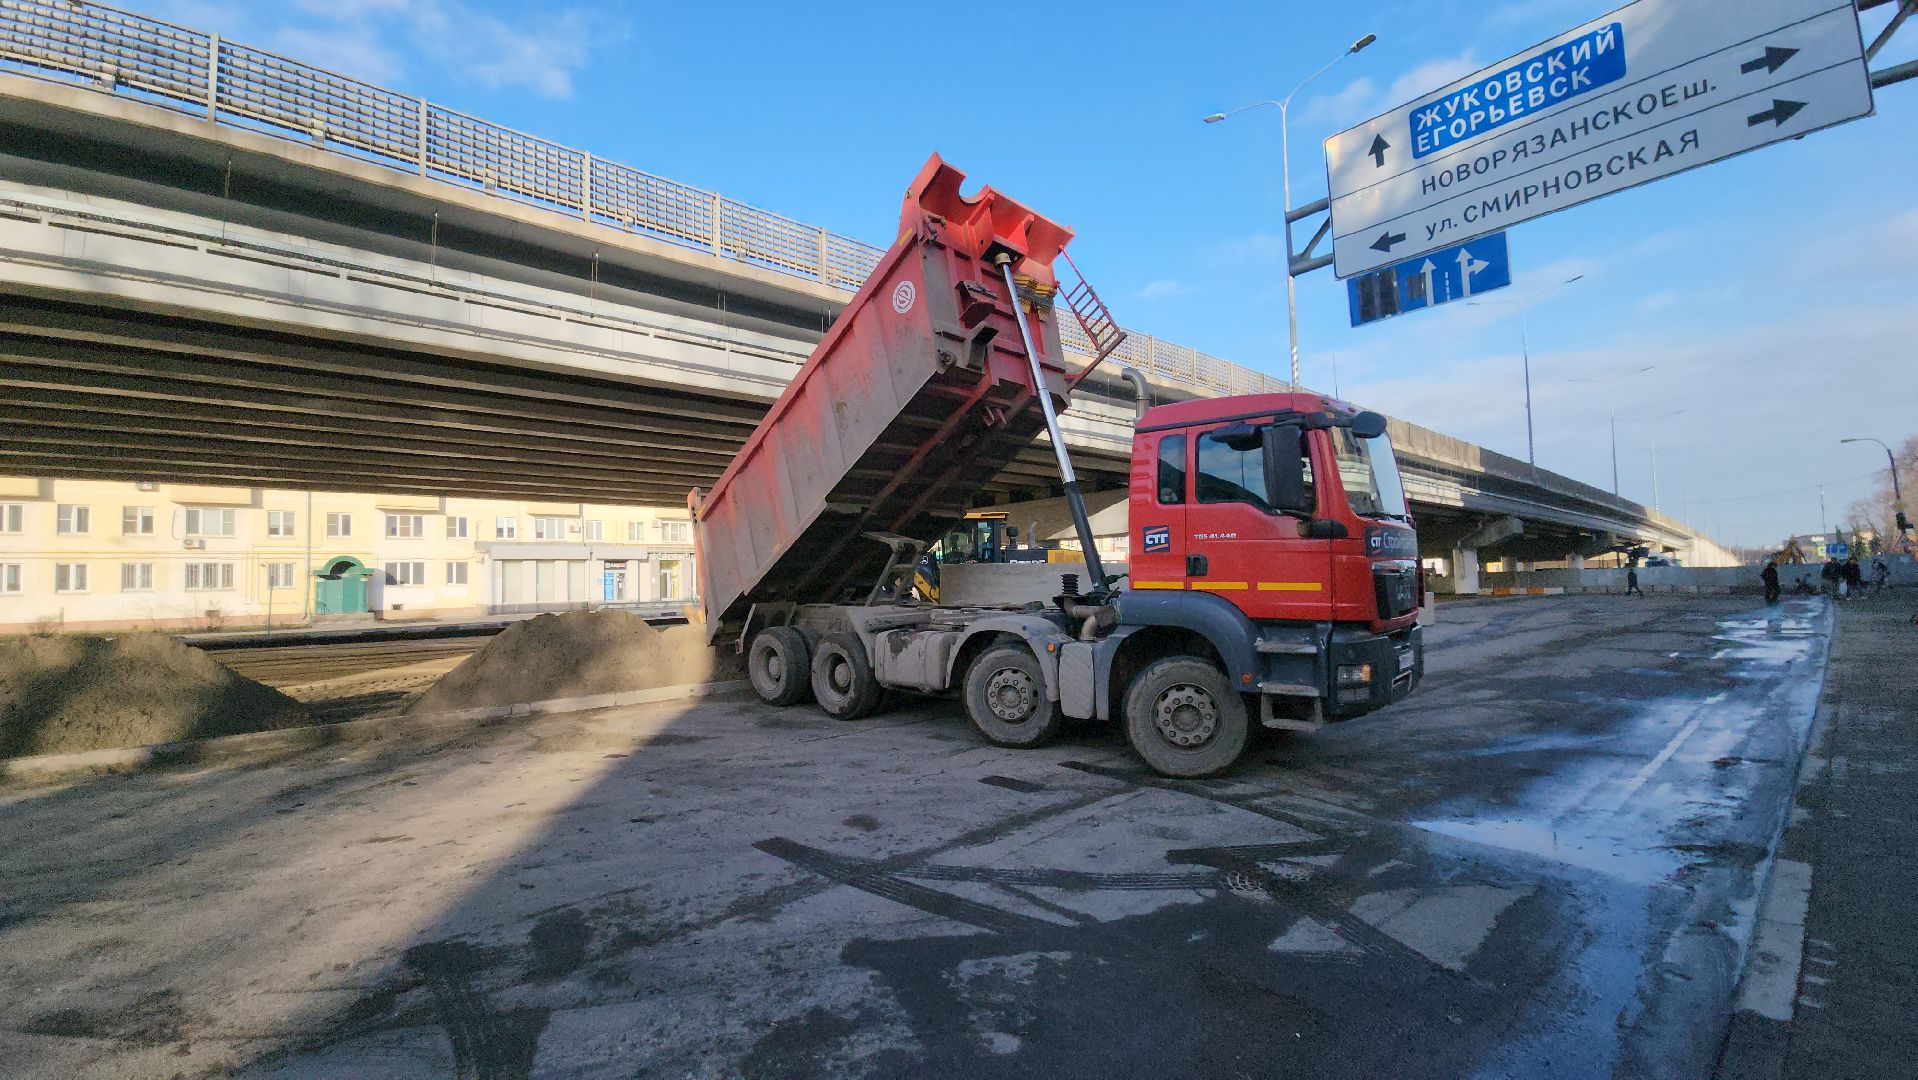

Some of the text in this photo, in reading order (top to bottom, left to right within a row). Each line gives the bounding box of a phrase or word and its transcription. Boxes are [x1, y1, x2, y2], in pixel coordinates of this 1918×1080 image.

[1417, 25, 1616, 131] ЖУКОВСКИЙ
[1417, 66, 1592, 153] ЕГОРЬЕВСК
[1426, 129, 1700, 241] ул. СМИРНОВСКАЯ
[1145, 533, 1169, 545] СТГ
